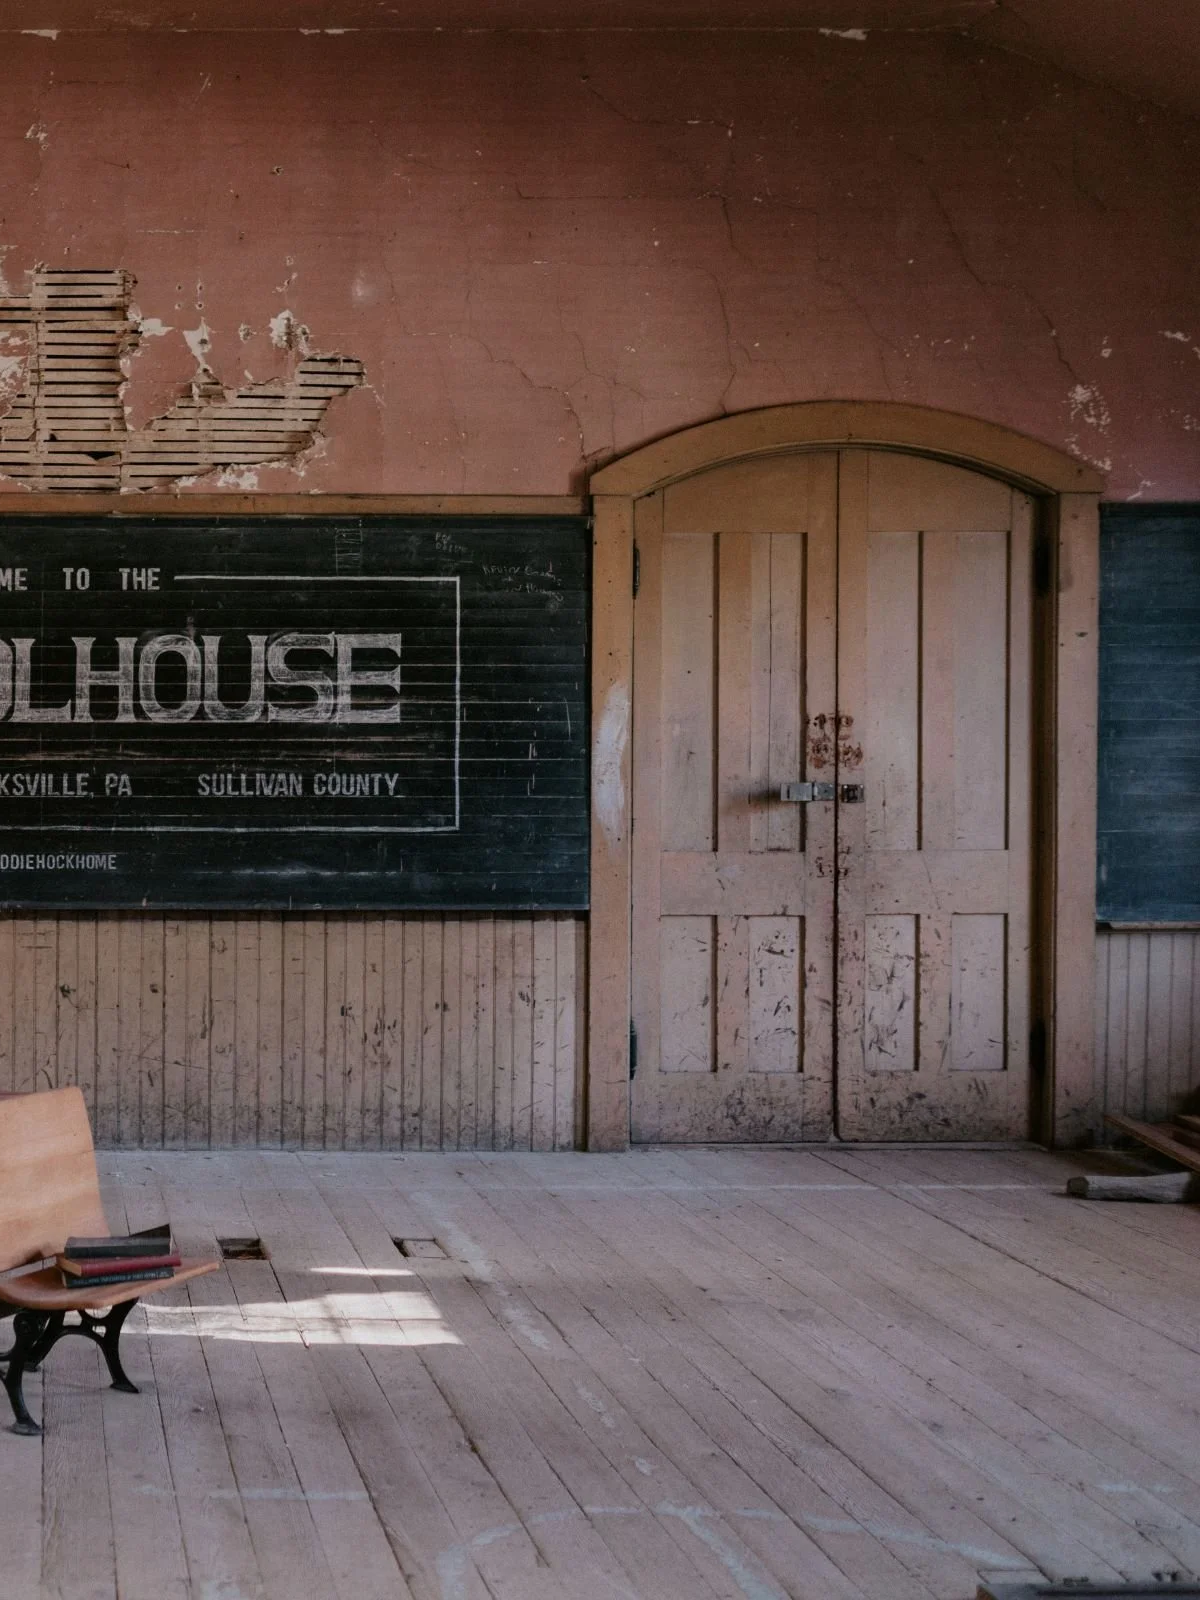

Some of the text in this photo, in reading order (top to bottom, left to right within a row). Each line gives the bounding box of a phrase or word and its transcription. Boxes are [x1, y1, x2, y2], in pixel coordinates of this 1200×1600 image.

[62, 567, 90, 591] TO
[119, 567, 161, 591] THE
[105, 773, 133, 797] PA
[197, 773, 399, 797] SULLIVAN COUNTY
